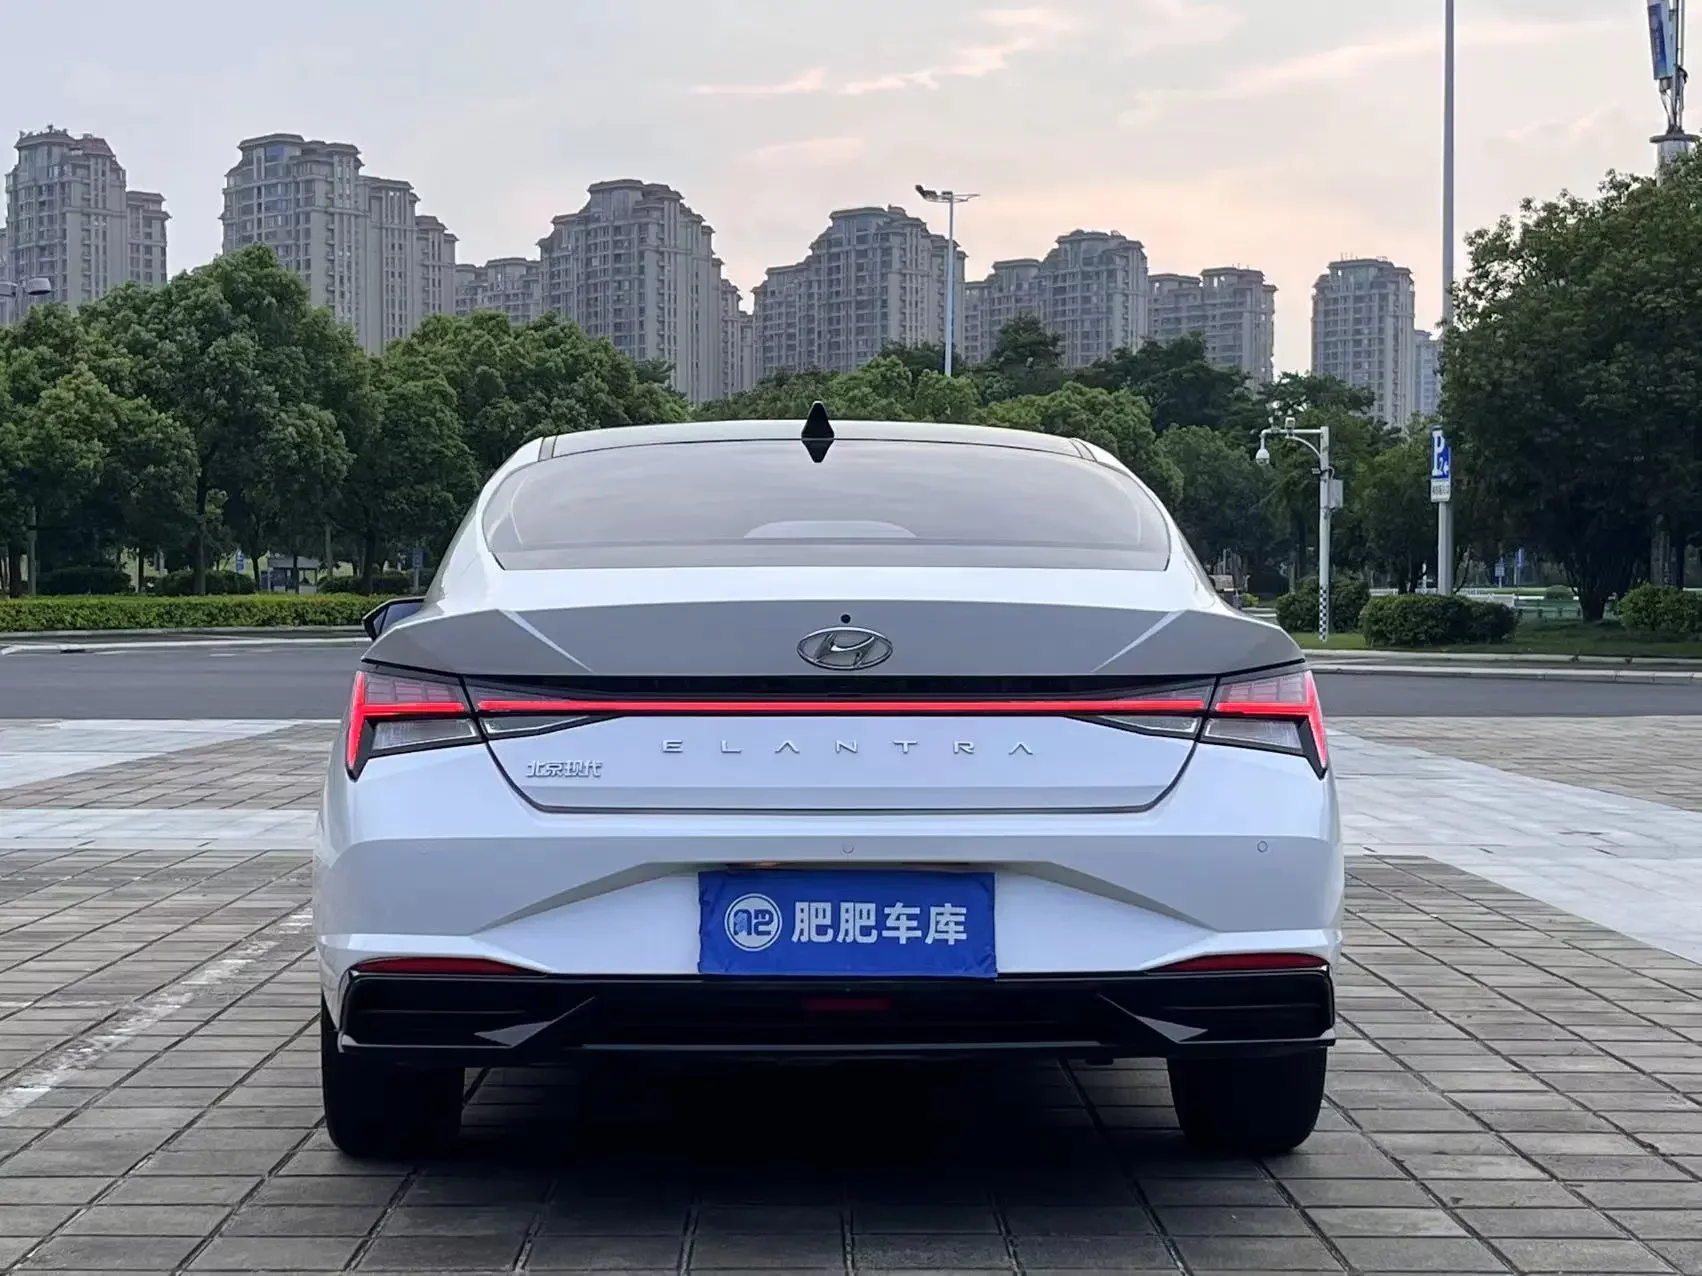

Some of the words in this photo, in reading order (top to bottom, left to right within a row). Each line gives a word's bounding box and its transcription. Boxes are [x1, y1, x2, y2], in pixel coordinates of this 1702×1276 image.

[661, 739, 1034, 756] ELANTRA
[526, 759, 603, 778] 北京现代
[791, 901, 968, 945] 肥肥车库
